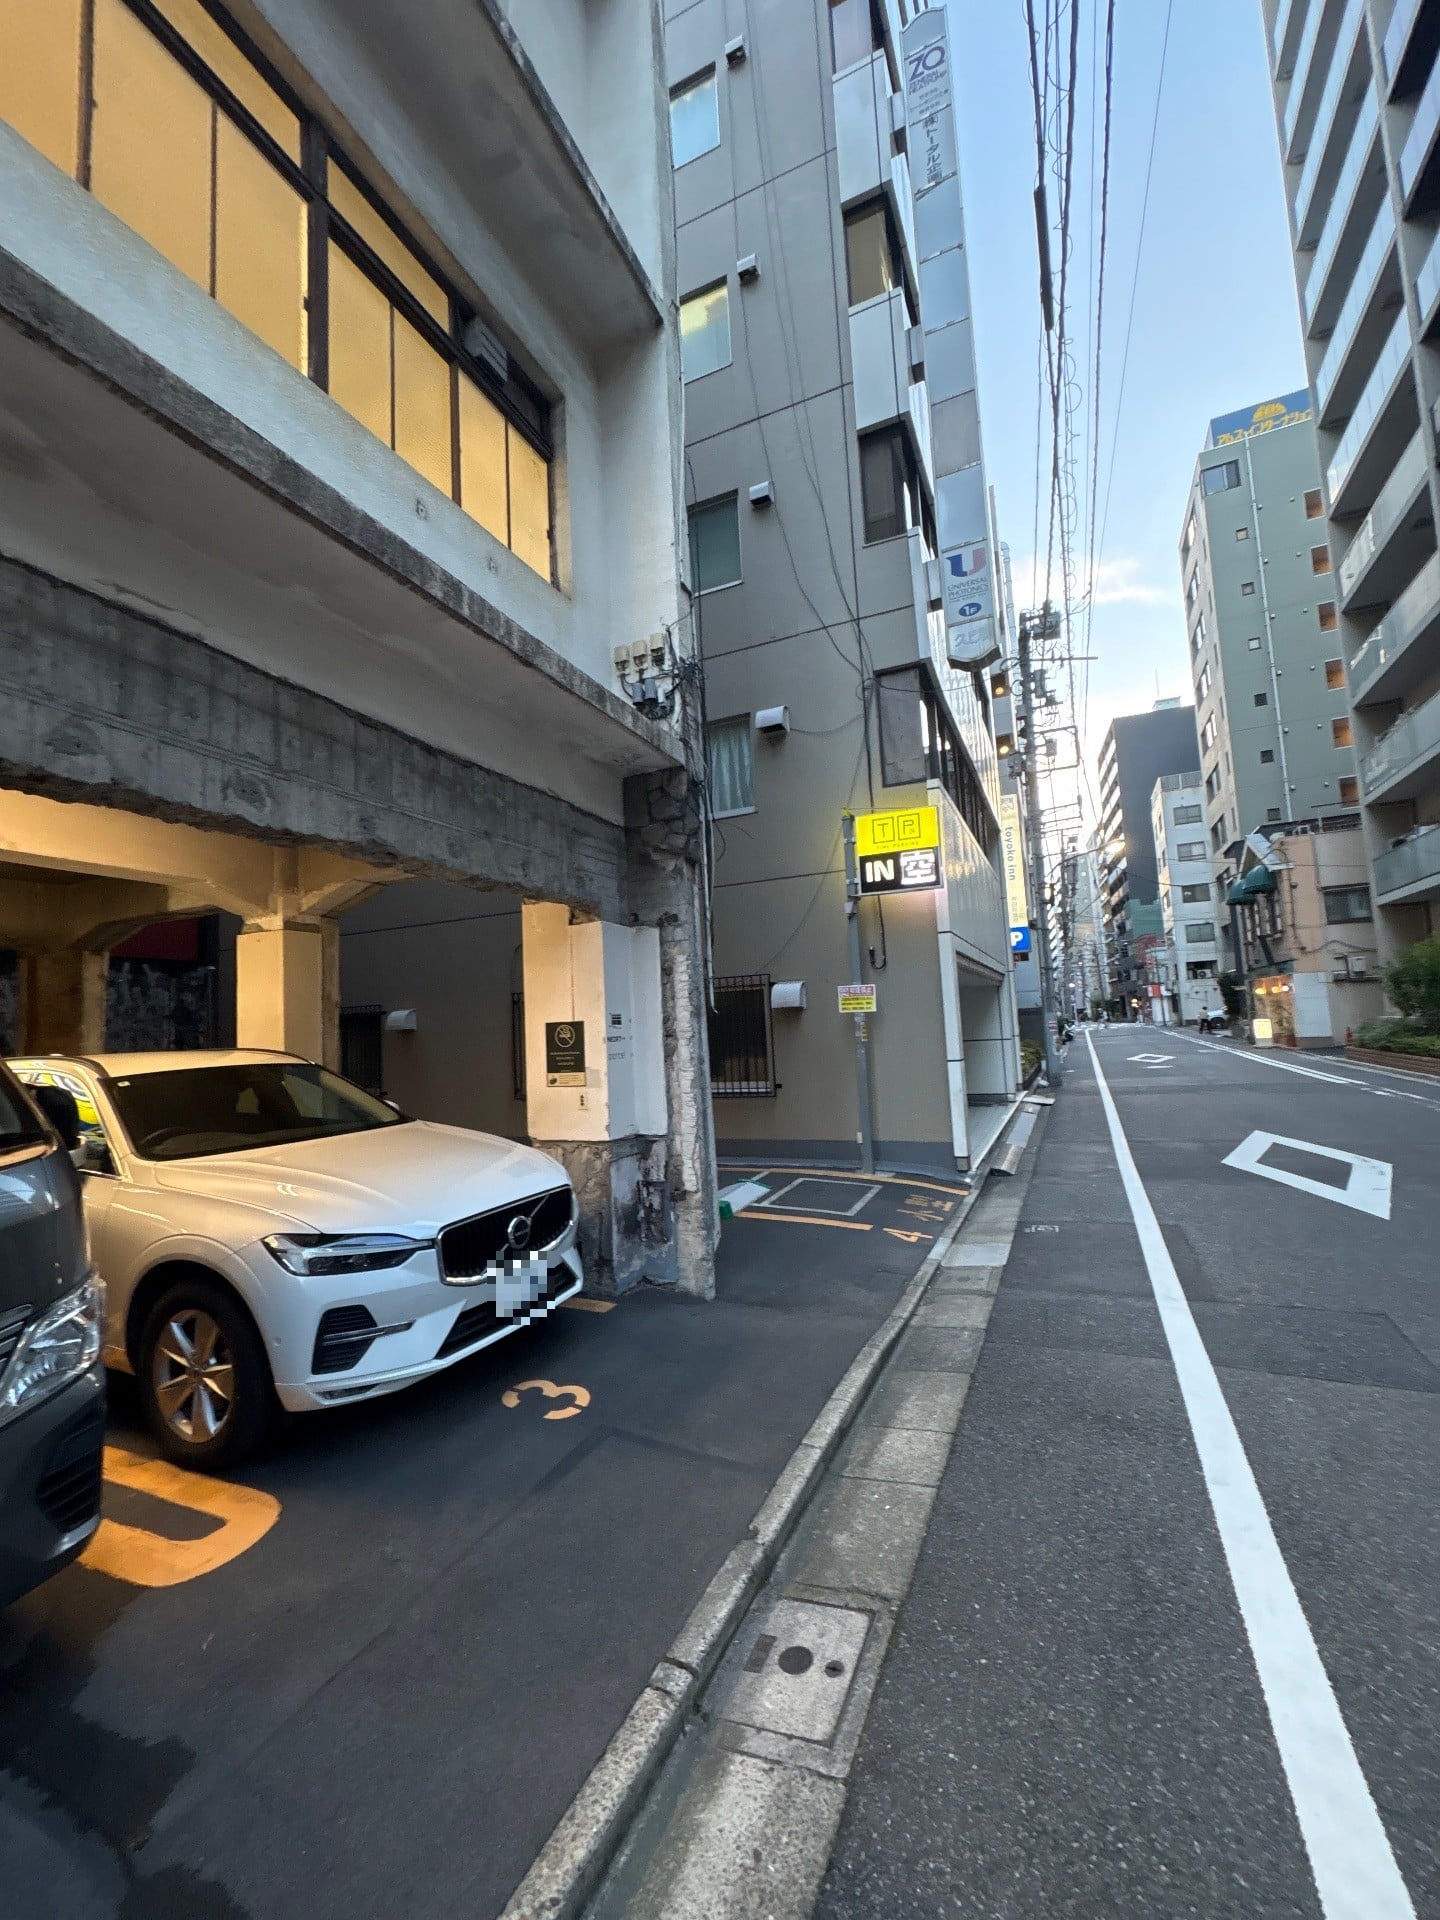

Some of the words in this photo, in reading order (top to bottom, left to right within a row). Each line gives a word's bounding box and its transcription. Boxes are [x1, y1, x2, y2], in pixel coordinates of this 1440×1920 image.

[963, 605, 978, 616] 1F
[1004, 826, 1016, 862] toyoko
[865, 859, 895, 883] IN
[899, 849, 937, 886] 空
[1007, 863, 1016, 881] inn
[1010, 931, 1024, 947] P
[501, 1379, 592, 1420] 3
